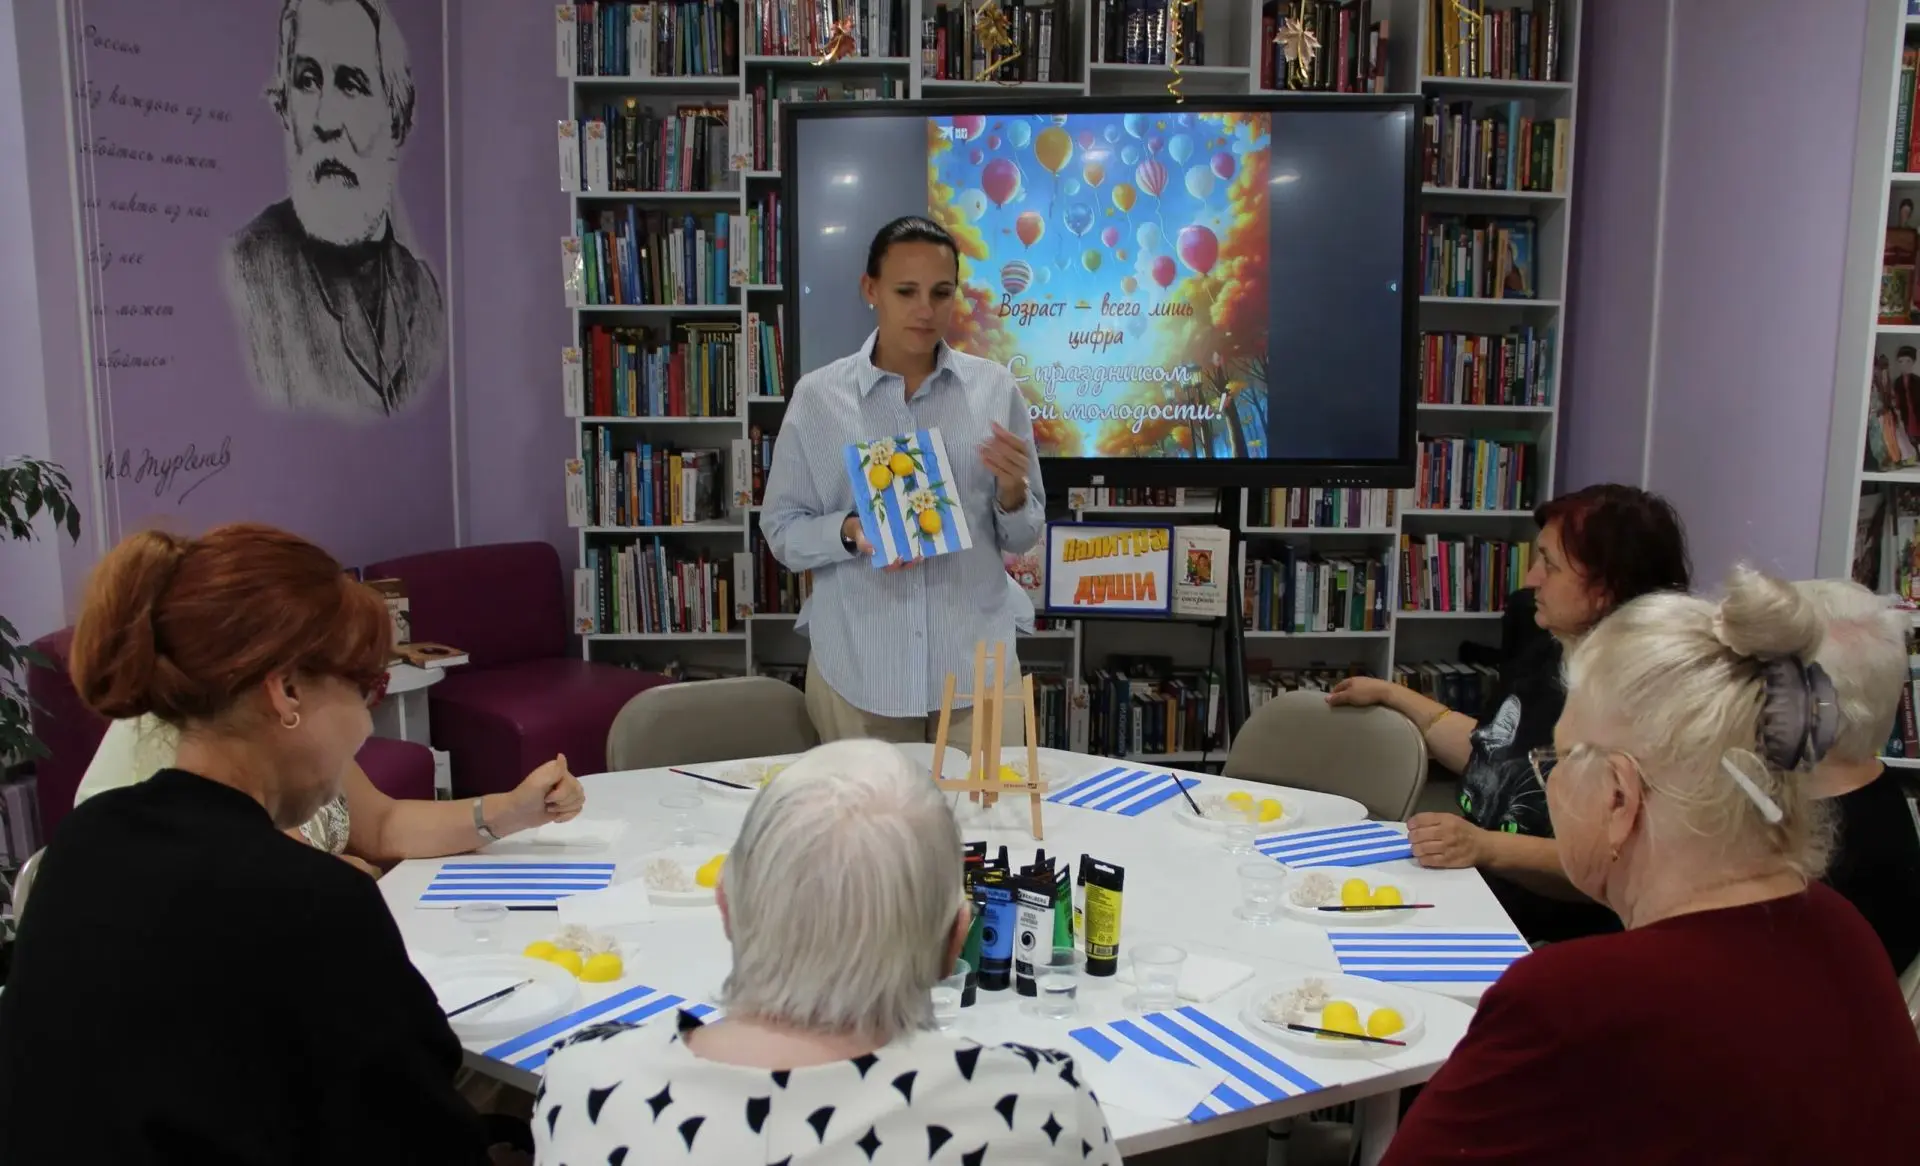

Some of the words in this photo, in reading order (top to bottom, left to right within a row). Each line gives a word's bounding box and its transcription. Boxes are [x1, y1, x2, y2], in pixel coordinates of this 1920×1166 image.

[108, 83, 180, 118] каждого
[186, 105, 203, 126] из
[998, 292, 1067, 326] Возраст
[1101, 291, 1141, 317] всего
[1148, 300, 1194, 317] лишь
[1068, 323, 1124, 354] цифра
[1006, 353, 1030, 382] С
[1035, 364, 1192, 397] праздником
[1063, 391, 1227, 434] молодости!
